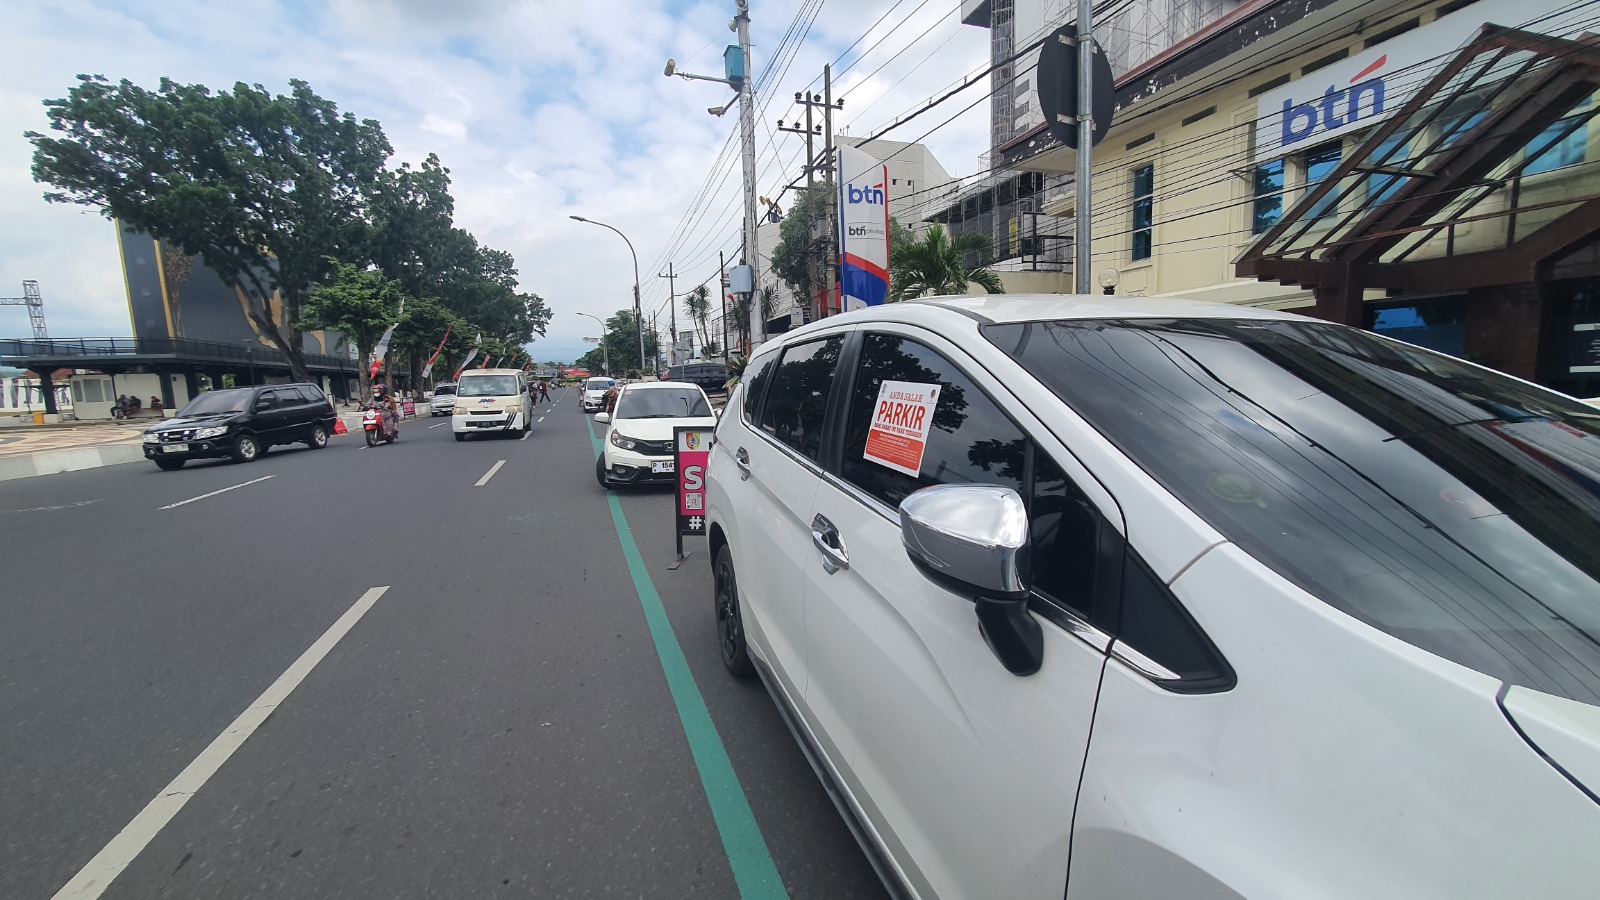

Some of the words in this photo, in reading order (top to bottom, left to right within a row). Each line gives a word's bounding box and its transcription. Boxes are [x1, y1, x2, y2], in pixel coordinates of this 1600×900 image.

[889, 390, 904, 400] ANDA
[903, 392, 924, 403] SALAH
[877, 400, 926, 431] PARKIR
